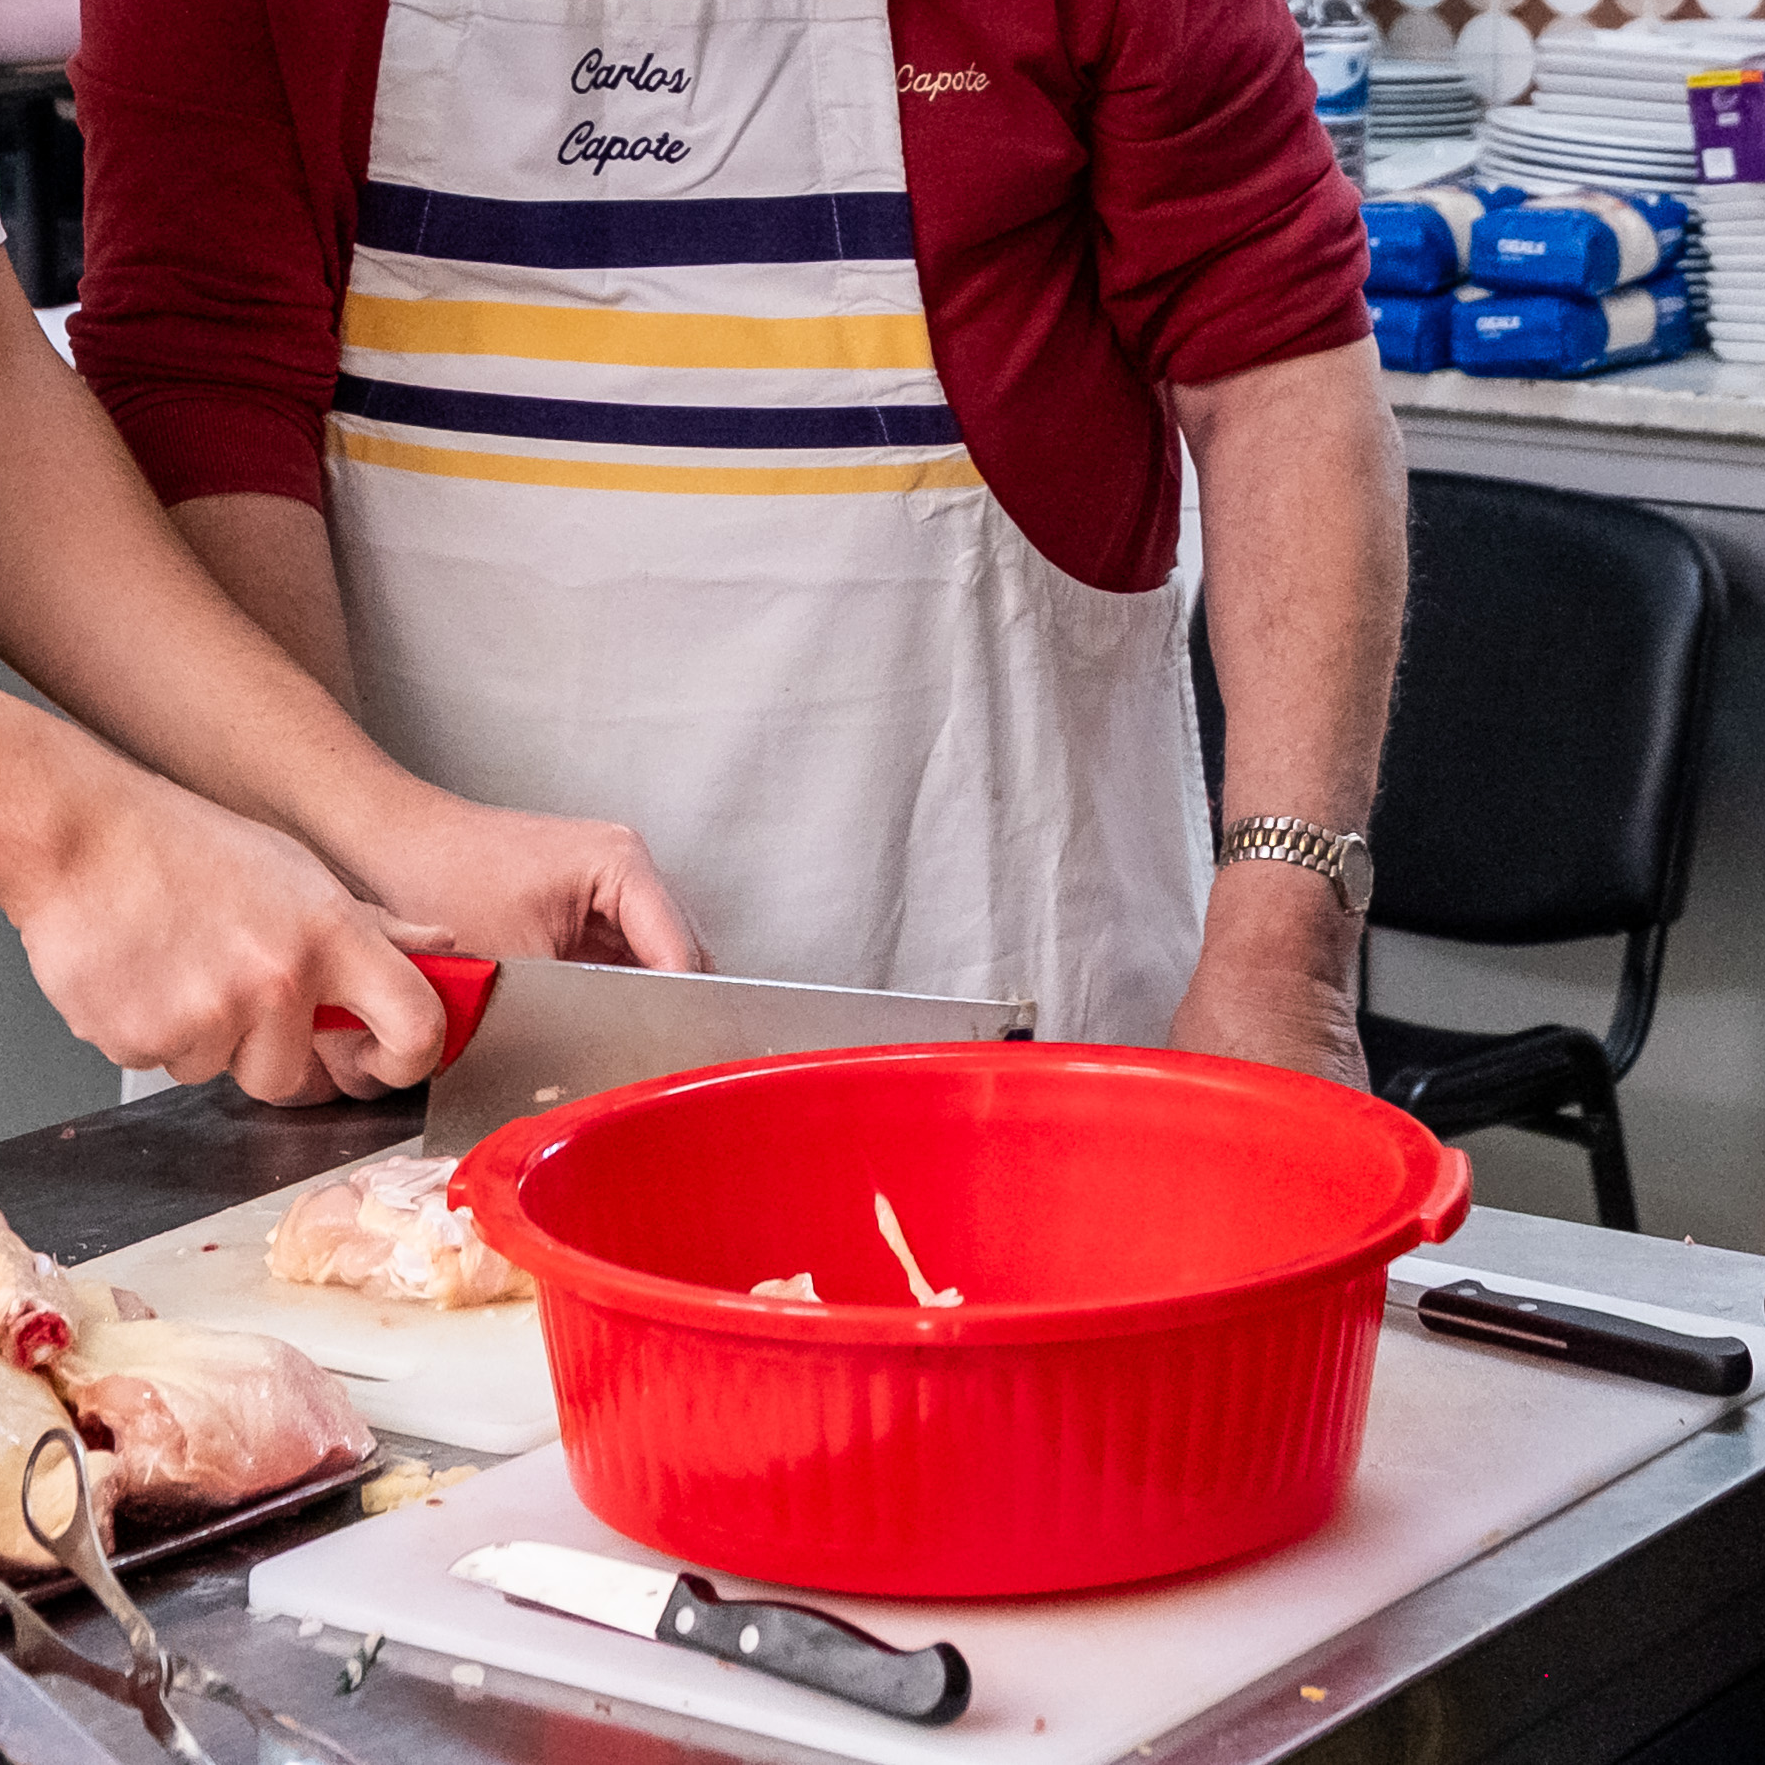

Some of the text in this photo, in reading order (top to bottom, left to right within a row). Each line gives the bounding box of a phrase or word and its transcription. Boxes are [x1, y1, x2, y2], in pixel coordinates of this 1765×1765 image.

[570, 47, 692, 95] Carlos
[895, 61, 992, 102] Capote
[557, 120, 691, 176] Capote
